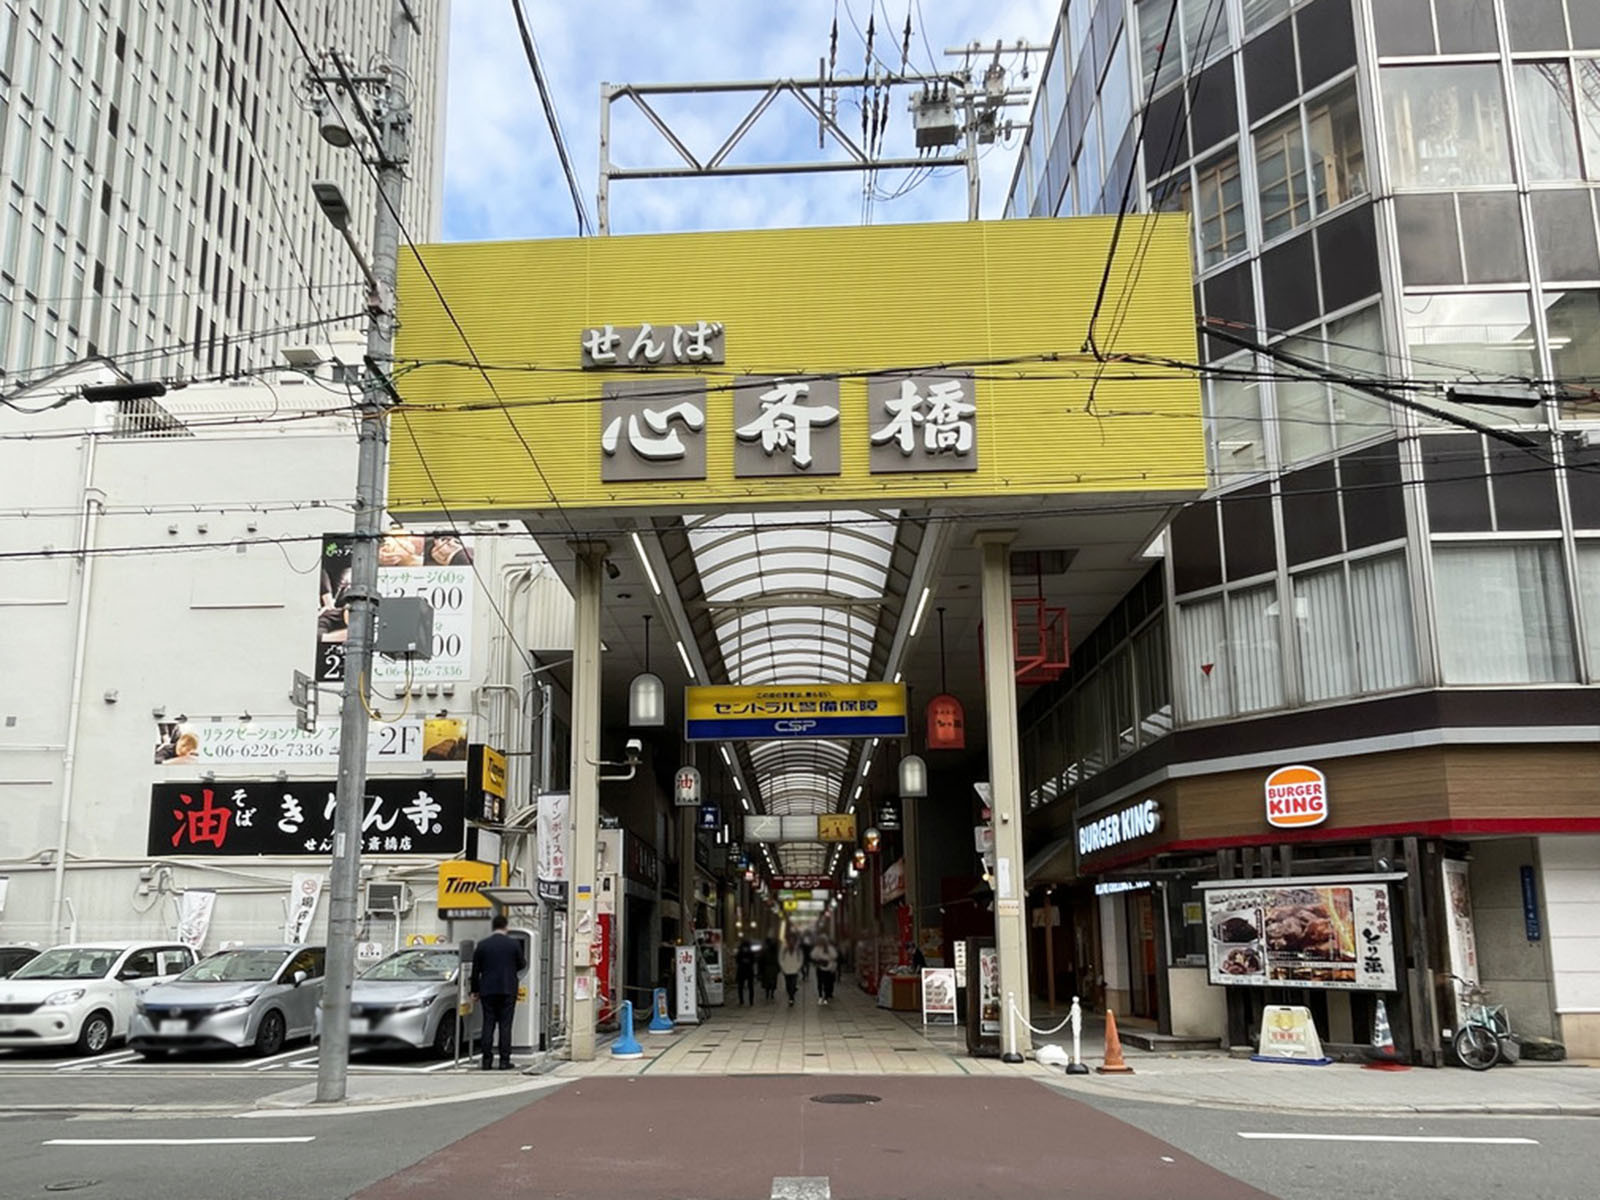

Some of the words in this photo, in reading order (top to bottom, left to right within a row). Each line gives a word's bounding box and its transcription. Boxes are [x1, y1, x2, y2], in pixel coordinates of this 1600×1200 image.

[582, 321, 723, 362] せんば
[774, 720, 817, 732] CSP
[215, 743, 324, 758] 06-6226-7336
[378, 726, 421, 756] 2F
[1268, 784, 1322, 799] BURGER
[1269, 796, 1323, 815] KING
[1079, 813, 1121, 855] BURGER
[1120, 799, 1157, 841] KING
